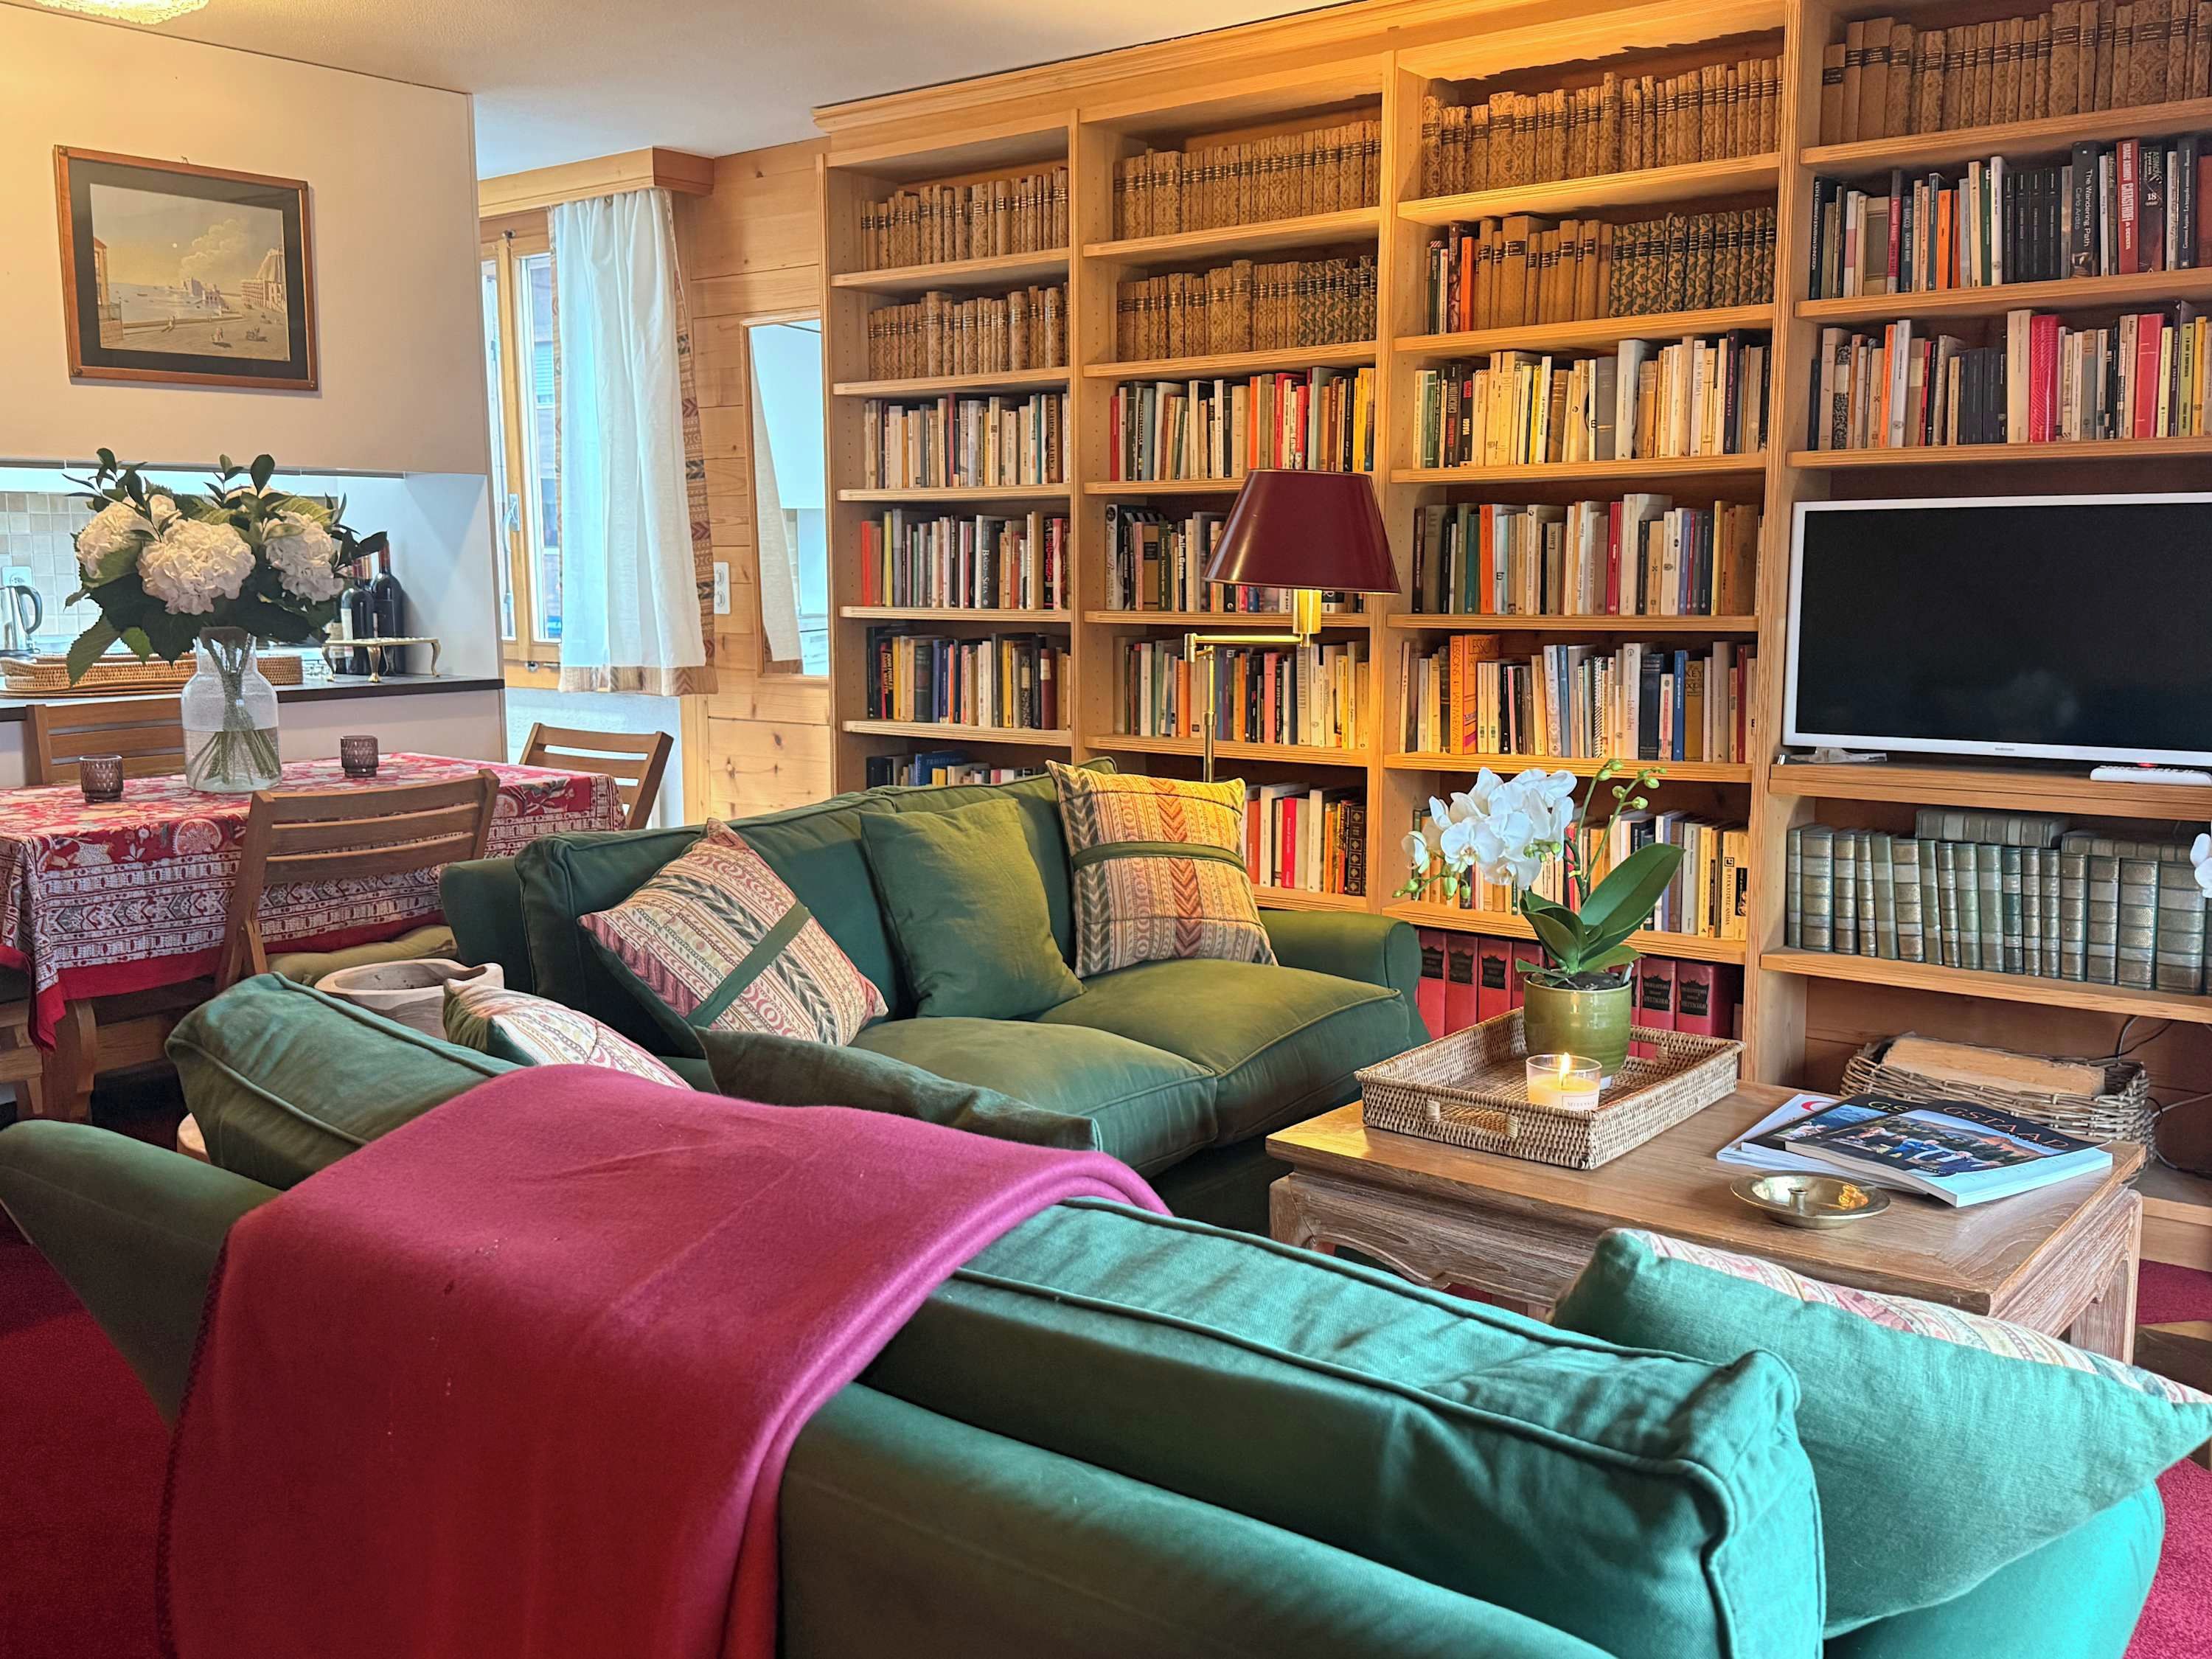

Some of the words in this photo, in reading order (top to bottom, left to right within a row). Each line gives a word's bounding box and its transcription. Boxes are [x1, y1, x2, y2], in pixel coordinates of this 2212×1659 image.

[2074, 208, 2082, 230] Ardito
[2084, 186, 2093, 226] Wandering
[1453, 640, 1461, 676] LESSONS
[1453, 692, 1461, 707] IAN
[1941, 1106, 2069, 1148] GSTAAD
